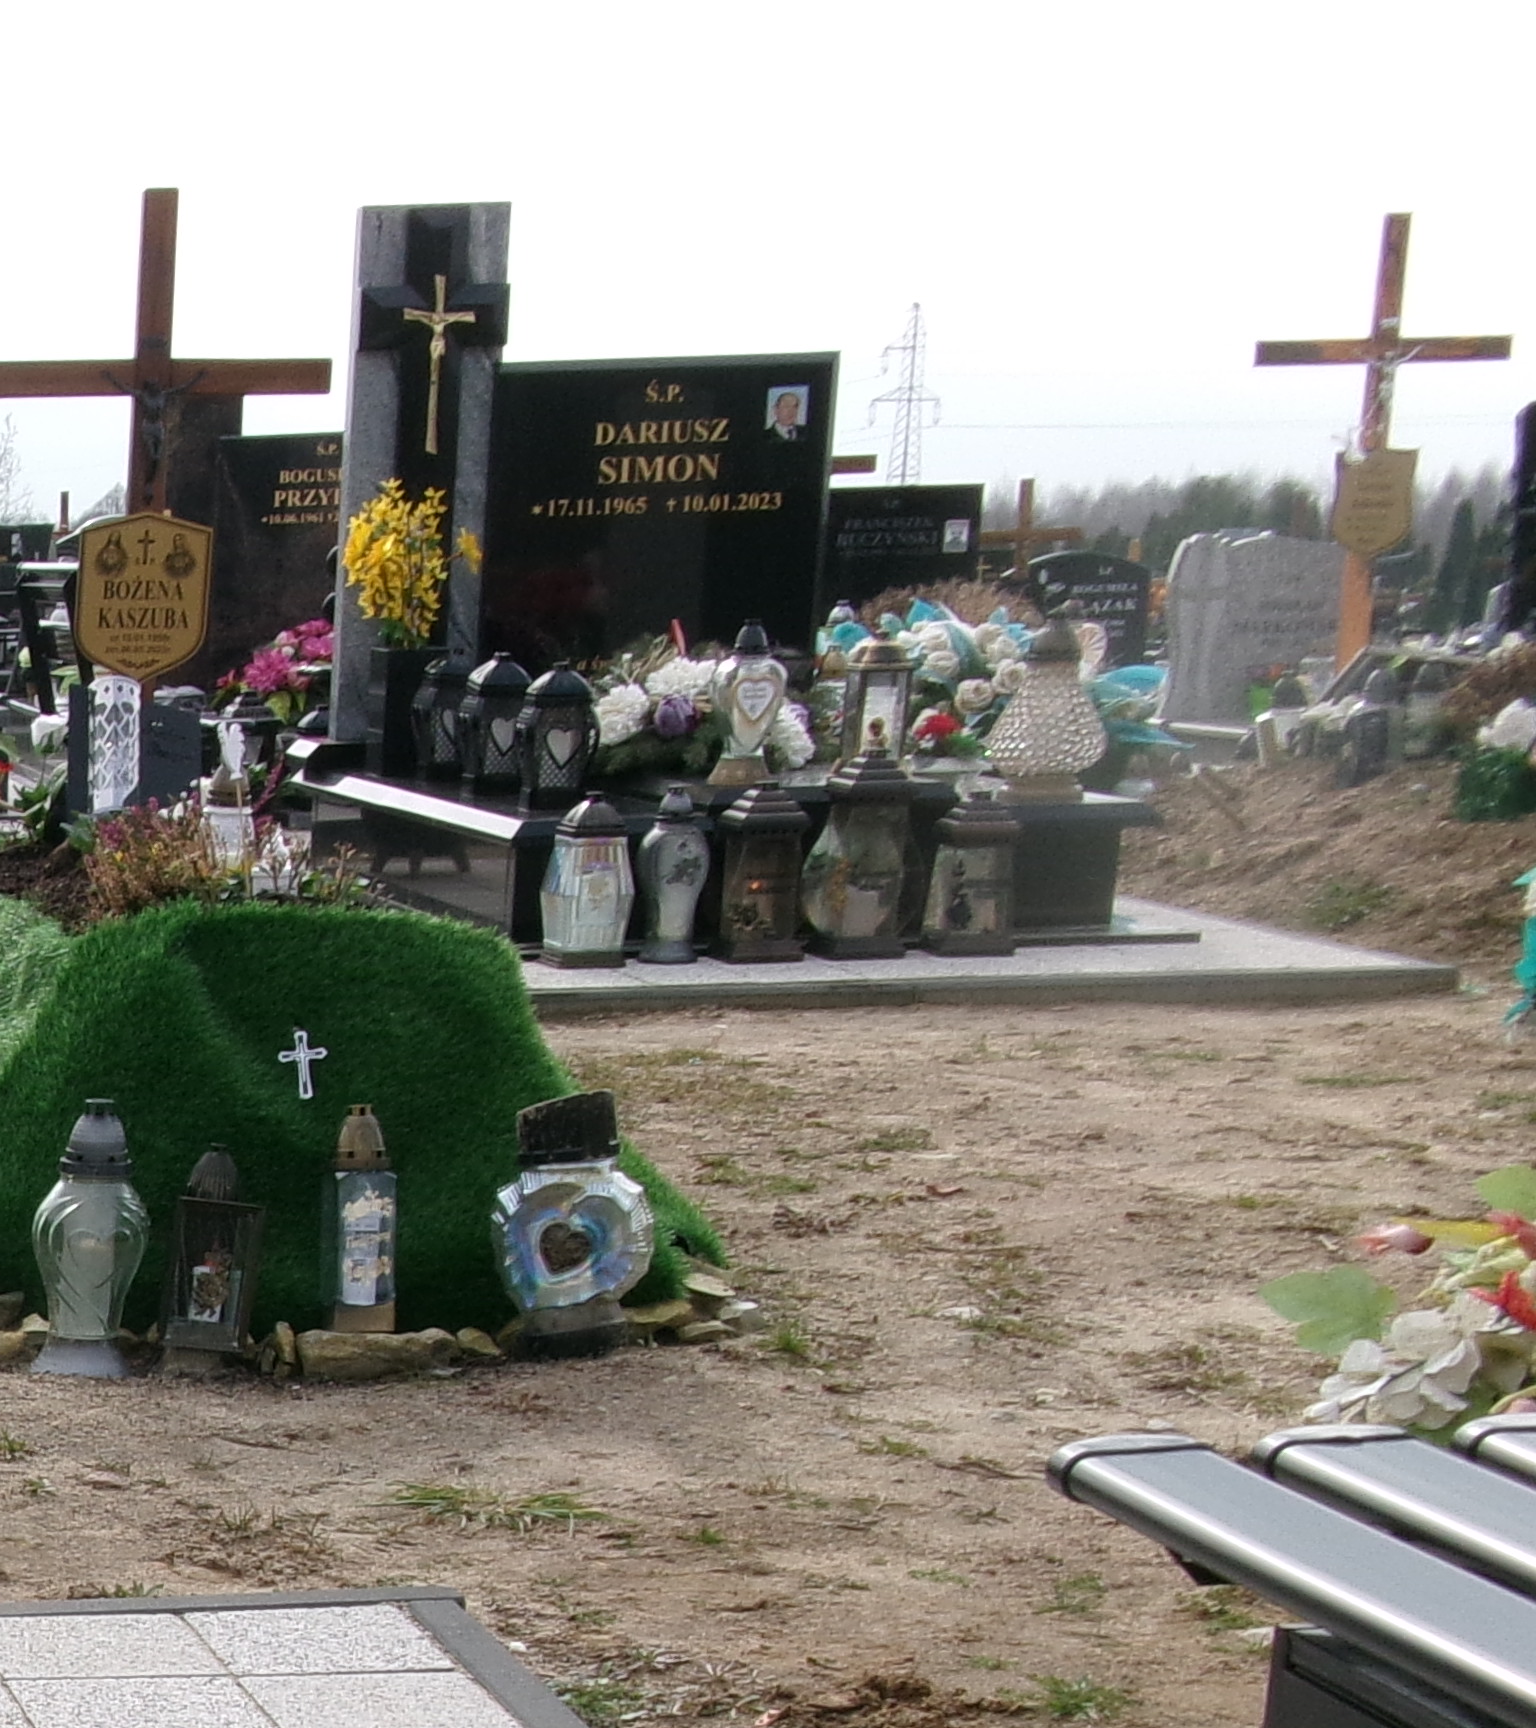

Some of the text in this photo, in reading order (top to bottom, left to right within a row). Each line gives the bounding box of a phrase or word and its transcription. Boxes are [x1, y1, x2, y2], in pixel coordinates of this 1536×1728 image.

[594, 418, 730, 446] DARIUSZ
[597, 453, 721, 485] SIMON
[548, 491, 783, 518] 17.11.1965 10.01.2023
[103, 575, 184, 601] BOŻENA
[98, 607, 188, 629] KASZUBA
